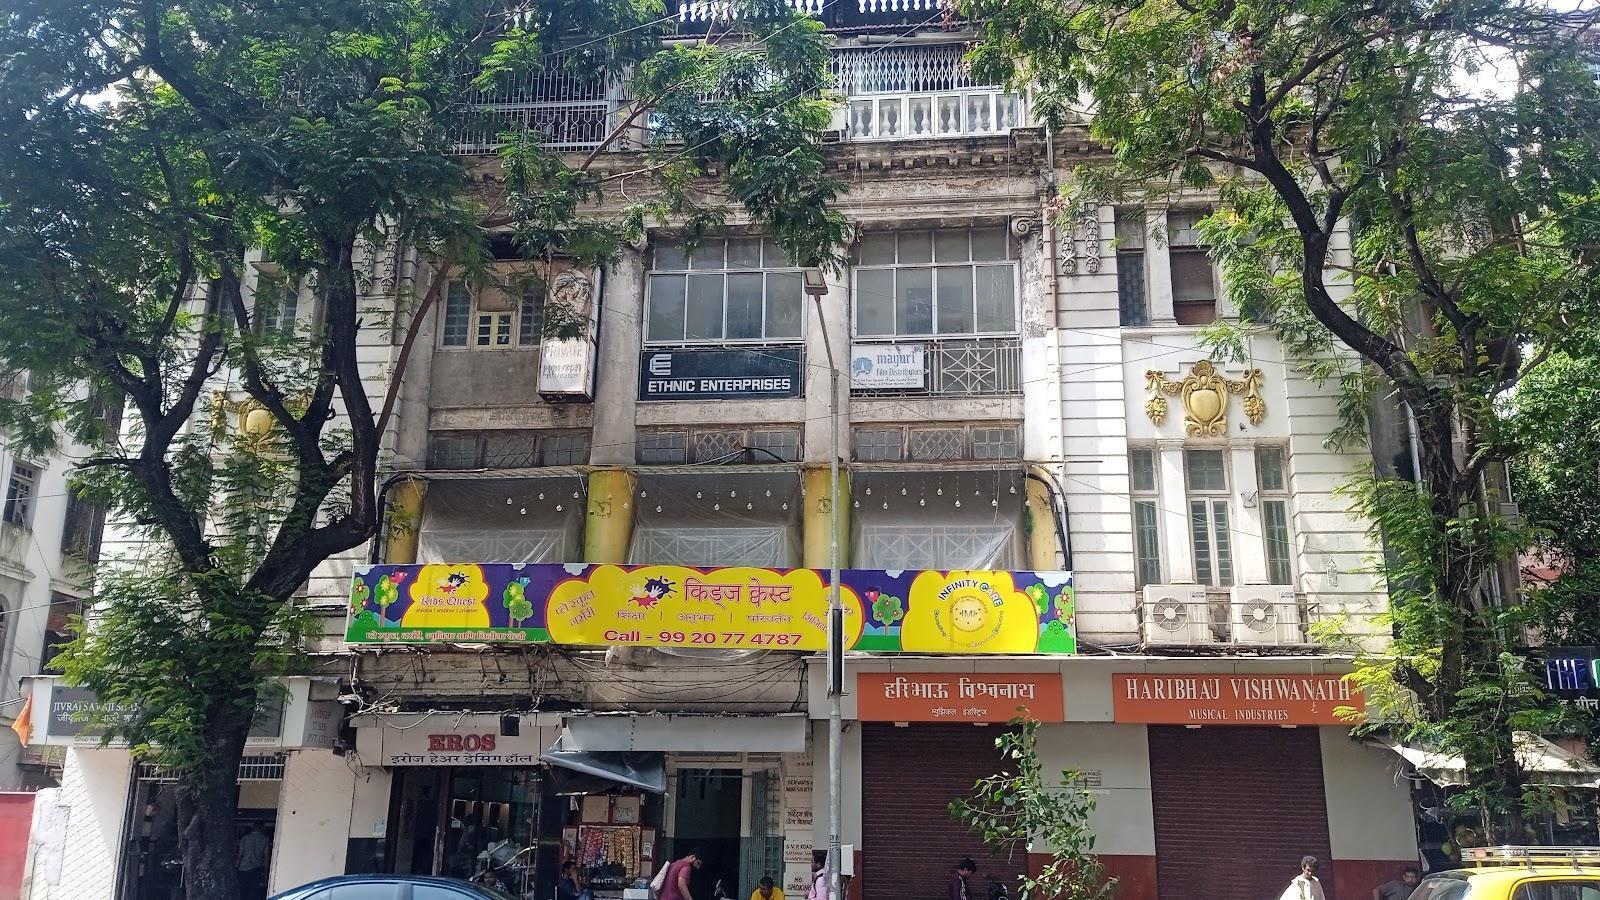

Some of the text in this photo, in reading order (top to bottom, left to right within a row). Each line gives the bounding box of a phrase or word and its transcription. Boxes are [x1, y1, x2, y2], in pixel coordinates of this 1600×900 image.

[877, 353, 916, 368] mayuri
[648, 378, 791, 393] ETHNIC ENTERPRISES
[446, 595, 476, 606] Quest
[684, 577, 743, 609] किड्ज
[748, 578, 793, 608] क्वेस्ट
[938, 579, 979, 601] INFINITY
[979, 582, 1004, 608] CARE
[603, 630, 641, 643] Call
[658, 631, 686, 644] 99
[690, 632, 717, 645] 20
[721, 632, 746, 645] 77
[750, 632, 803, 646] 4787
[884, 676, 1036, 700] हरिभाऊ विश्वनाथ
[1126, 678, 1352, 701] HARIBHAU VISHWANATH
[1188, 709, 1289, 721] MUSICAL INDUSTRIES
[427, 733, 496, 752] EROS
[390, 752, 533, 764] इरोज हेअर ड्रेसिंग हॉल
[787, 884, 812, 892] SMOKING
